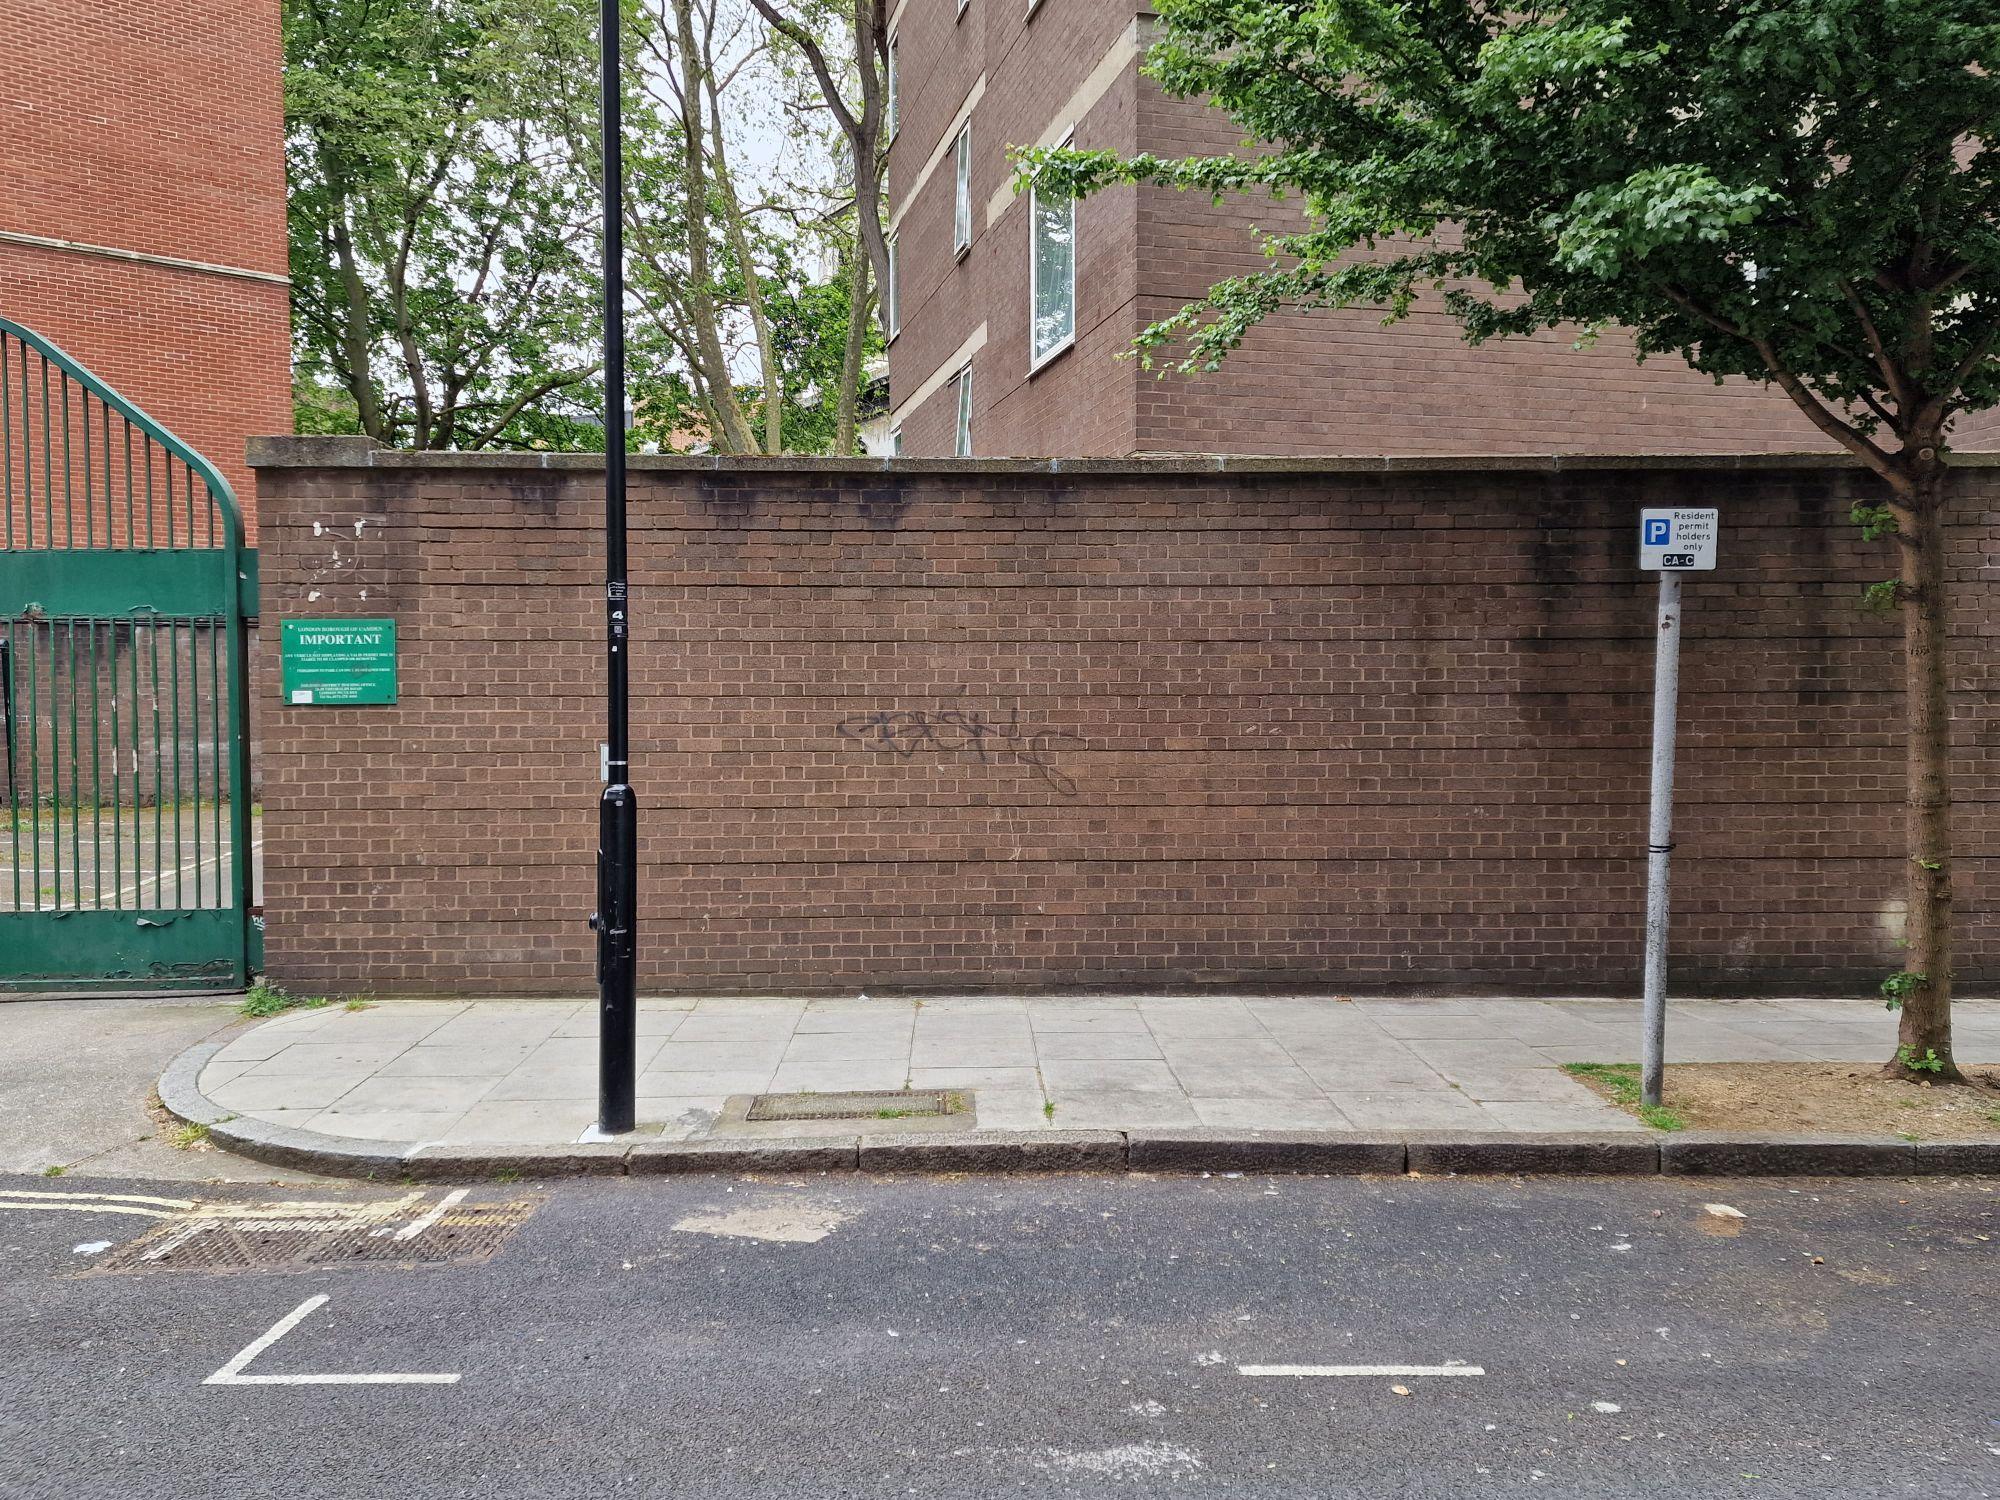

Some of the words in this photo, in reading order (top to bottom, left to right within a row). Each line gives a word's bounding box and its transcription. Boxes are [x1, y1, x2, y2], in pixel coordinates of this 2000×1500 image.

[1674, 512, 1715, 520] Resident
[1678, 523, 1709, 531] permit
[1651, 522, 1667, 543] P
[1676, 533, 1711, 541] holders
[1683, 543, 1703, 552] only
[1663, 555, 1694, 566] CA-C
[300, 634, 382, 645] IMPORTANT
